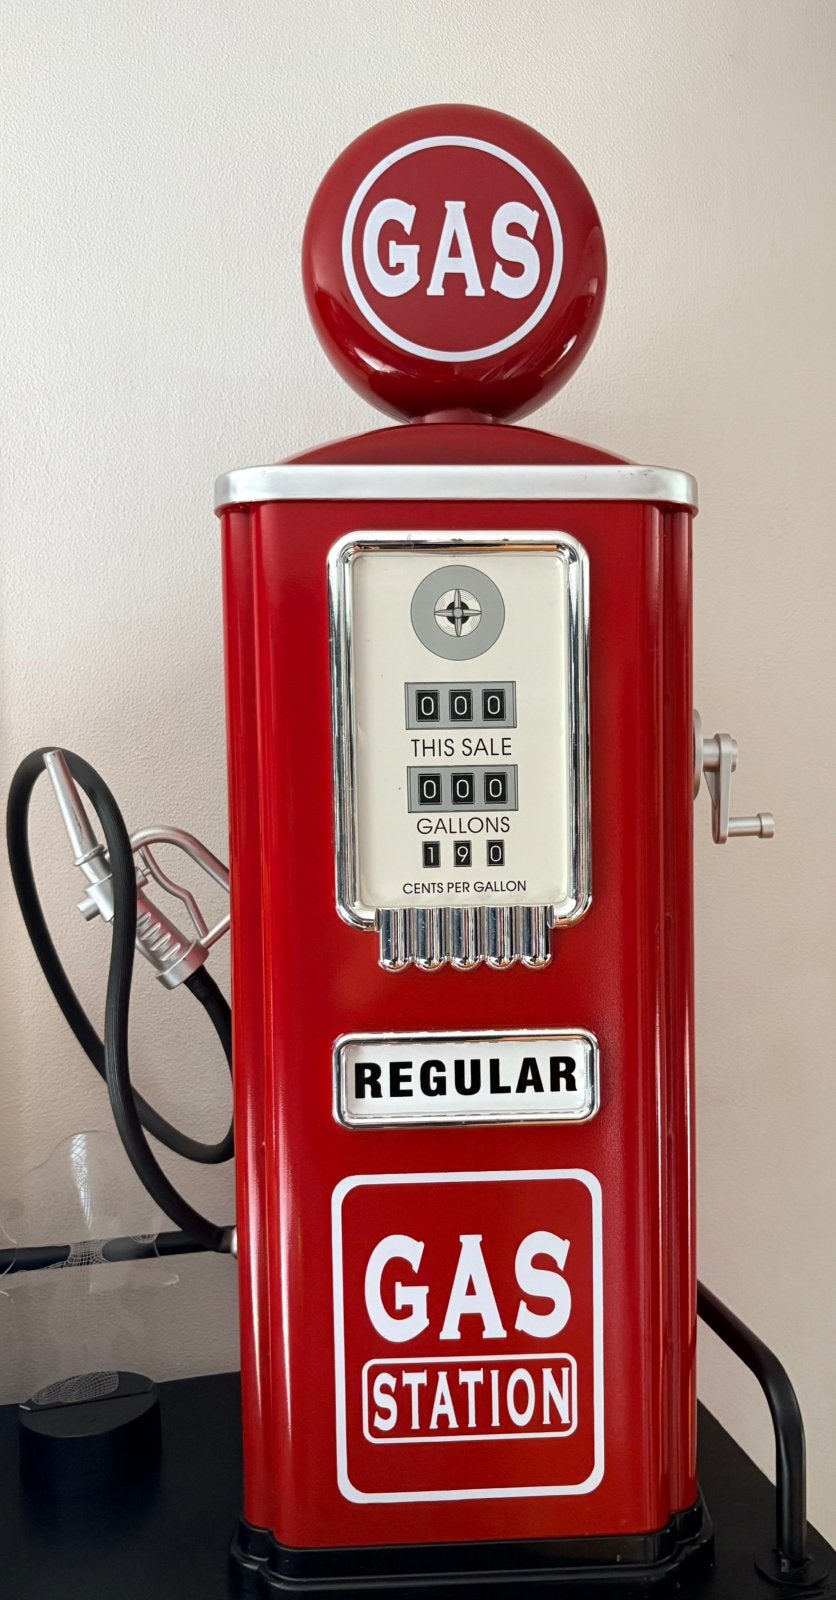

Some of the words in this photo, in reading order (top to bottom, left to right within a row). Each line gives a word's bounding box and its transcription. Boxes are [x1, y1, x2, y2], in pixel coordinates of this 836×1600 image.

[362, 198, 541, 300] GAS
[411, 738, 455, 757] THIS
[461, 737, 512, 757] SALE
[416, 816, 511, 835] GALLONS
[402, 882, 444, 894] CENTS
[448, 882, 470, 893] PER
[474, 880, 526, 893] GALLON
[354, 1055, 578, 1100] REGULAR
[364, 1230, 572, 1343] GAS
[372, 1366, 571, 1432] STATION
